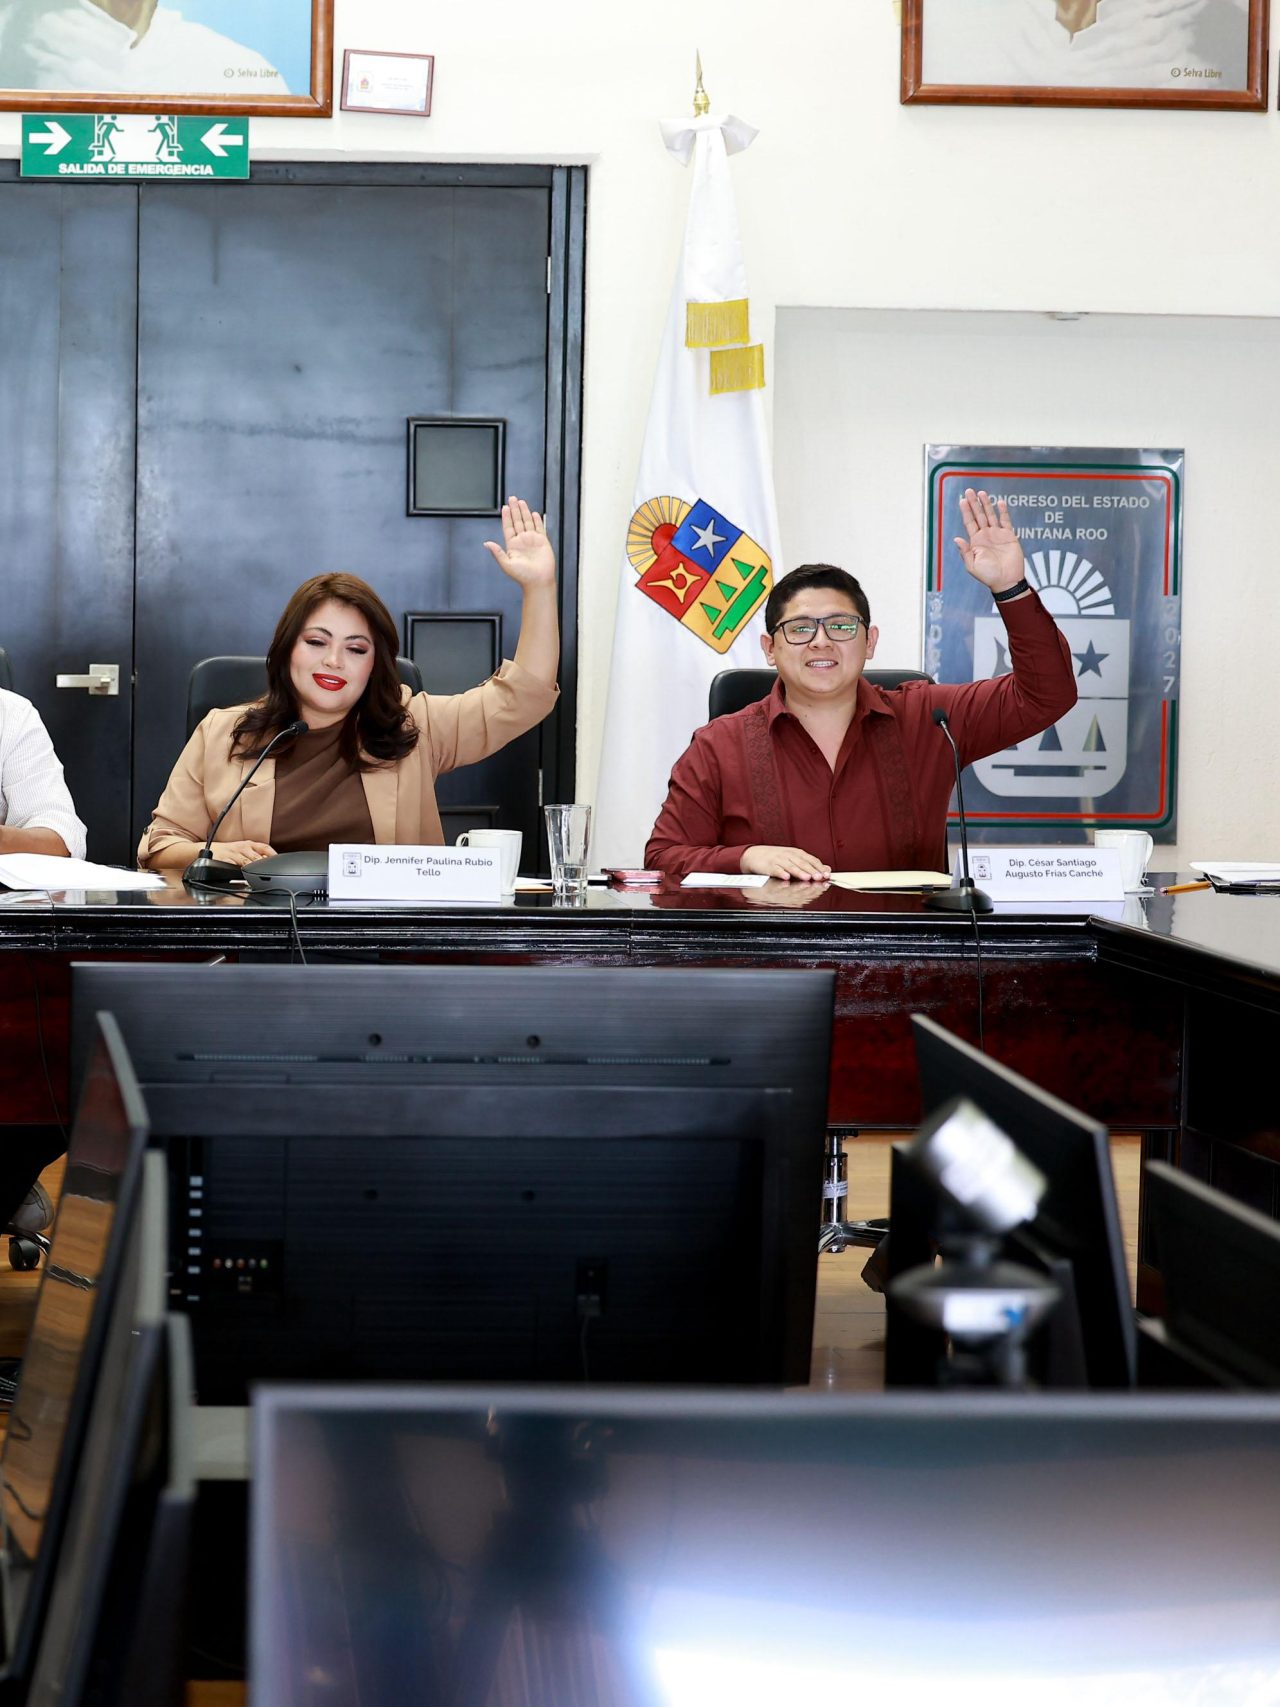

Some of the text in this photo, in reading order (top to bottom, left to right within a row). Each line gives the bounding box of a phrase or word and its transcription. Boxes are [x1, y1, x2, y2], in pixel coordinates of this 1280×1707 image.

[237, 68, 258, 78] Selva
[1183, 68, 1202, 78] Selva
[58, 163, 214, 175] SALIDA DE EMERGENCIA
[981, 495, 1057, 507] ONGRESO
[1062, 496, 1089, 508] DEL
[1093, 497, 1150, 508] ESTADO
[1044, 511, 1064, 524] DE
[1013, 527, 1108, 540] UINTANA ROO
[364, 856, 382, 865] Dip.
[385, 856, 423, 865] Jennifer
[426, 857, 462, 866] Paulina
[464, 857, 493, 866] Rubio
[1009, 858, 1097, 869] Dip. César Santiago
[416, 868, 441, 877] Tello
[1005, 869, 1103, 879] Augusto Frías Canché
